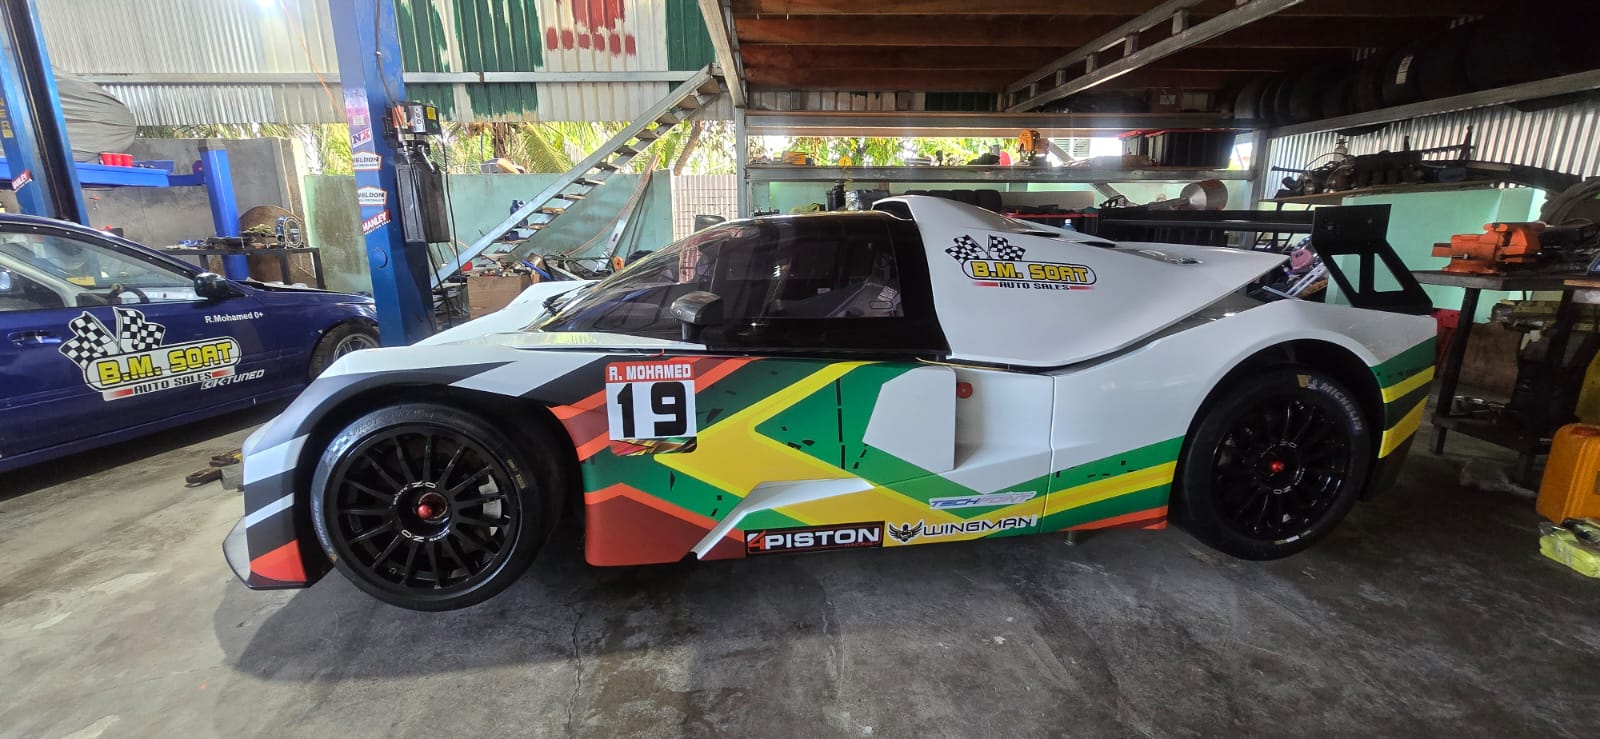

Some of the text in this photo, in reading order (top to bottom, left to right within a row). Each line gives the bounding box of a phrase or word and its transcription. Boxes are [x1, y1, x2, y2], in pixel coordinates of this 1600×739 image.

[971, 261, 1088, 282] B.M. SOAT
[97, 341, 233, 386] B.M. SOAT
[609, 364, 692, 381] R. MOHAMED
[134, 371, 212, 394] AUTO SALES
[617, 382, 687, 438] 19
[1319, 381, 1363, 431] MICHELIN
[923, 517, 1032, 536] WINGMAN
[746, 528, 880, 551] 4PISTON
